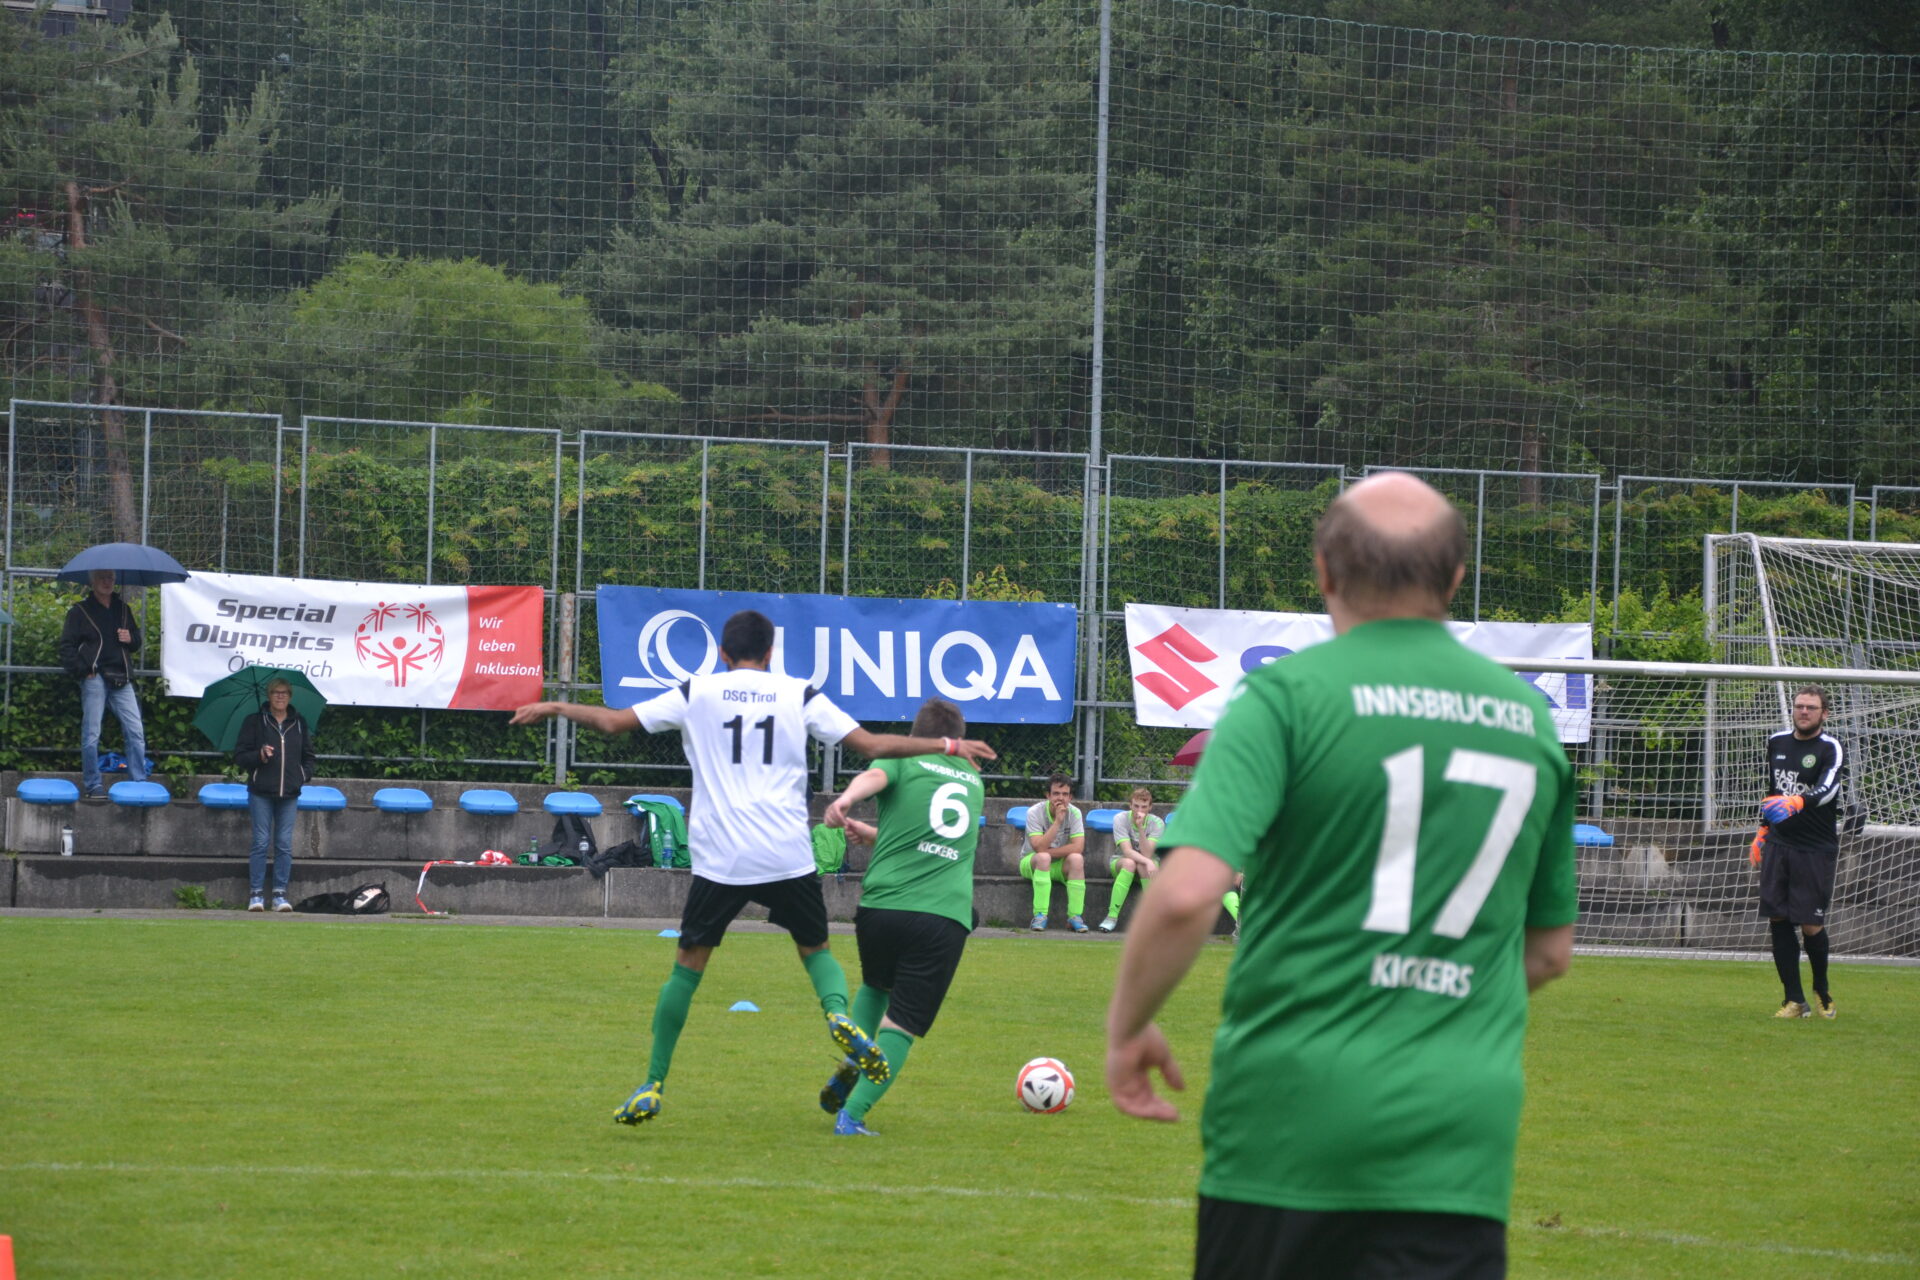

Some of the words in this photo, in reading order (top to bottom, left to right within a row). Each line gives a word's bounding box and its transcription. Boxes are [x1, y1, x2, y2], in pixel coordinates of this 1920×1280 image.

[216, 598, 337, 623] Special
[479, 616, 503, 629] Wir
[185, 623, 335, 653] Olympics
[478, 639, 516, 652] leben
[475, 662, 540, 677] Inklusion!
[769, 626, 1062, 701] UNIQA
[723, 689, 747, 703] DSG
[751, 691, 776, 703] Tirol
[1352, 684, 1537, 738] INNSBRUCKER
[723, 714, 775, 765] 11
[918, 760, 980, 786] NNSBRUCKE
[1774, 768, 1800, 783] EASY
[929, 782, 970, 839] 6
[917, 841, 960, 860] KICKERS
[1362, 744, 1537, 939] 17
[1369, 953, 1475, 998] KICKERS
